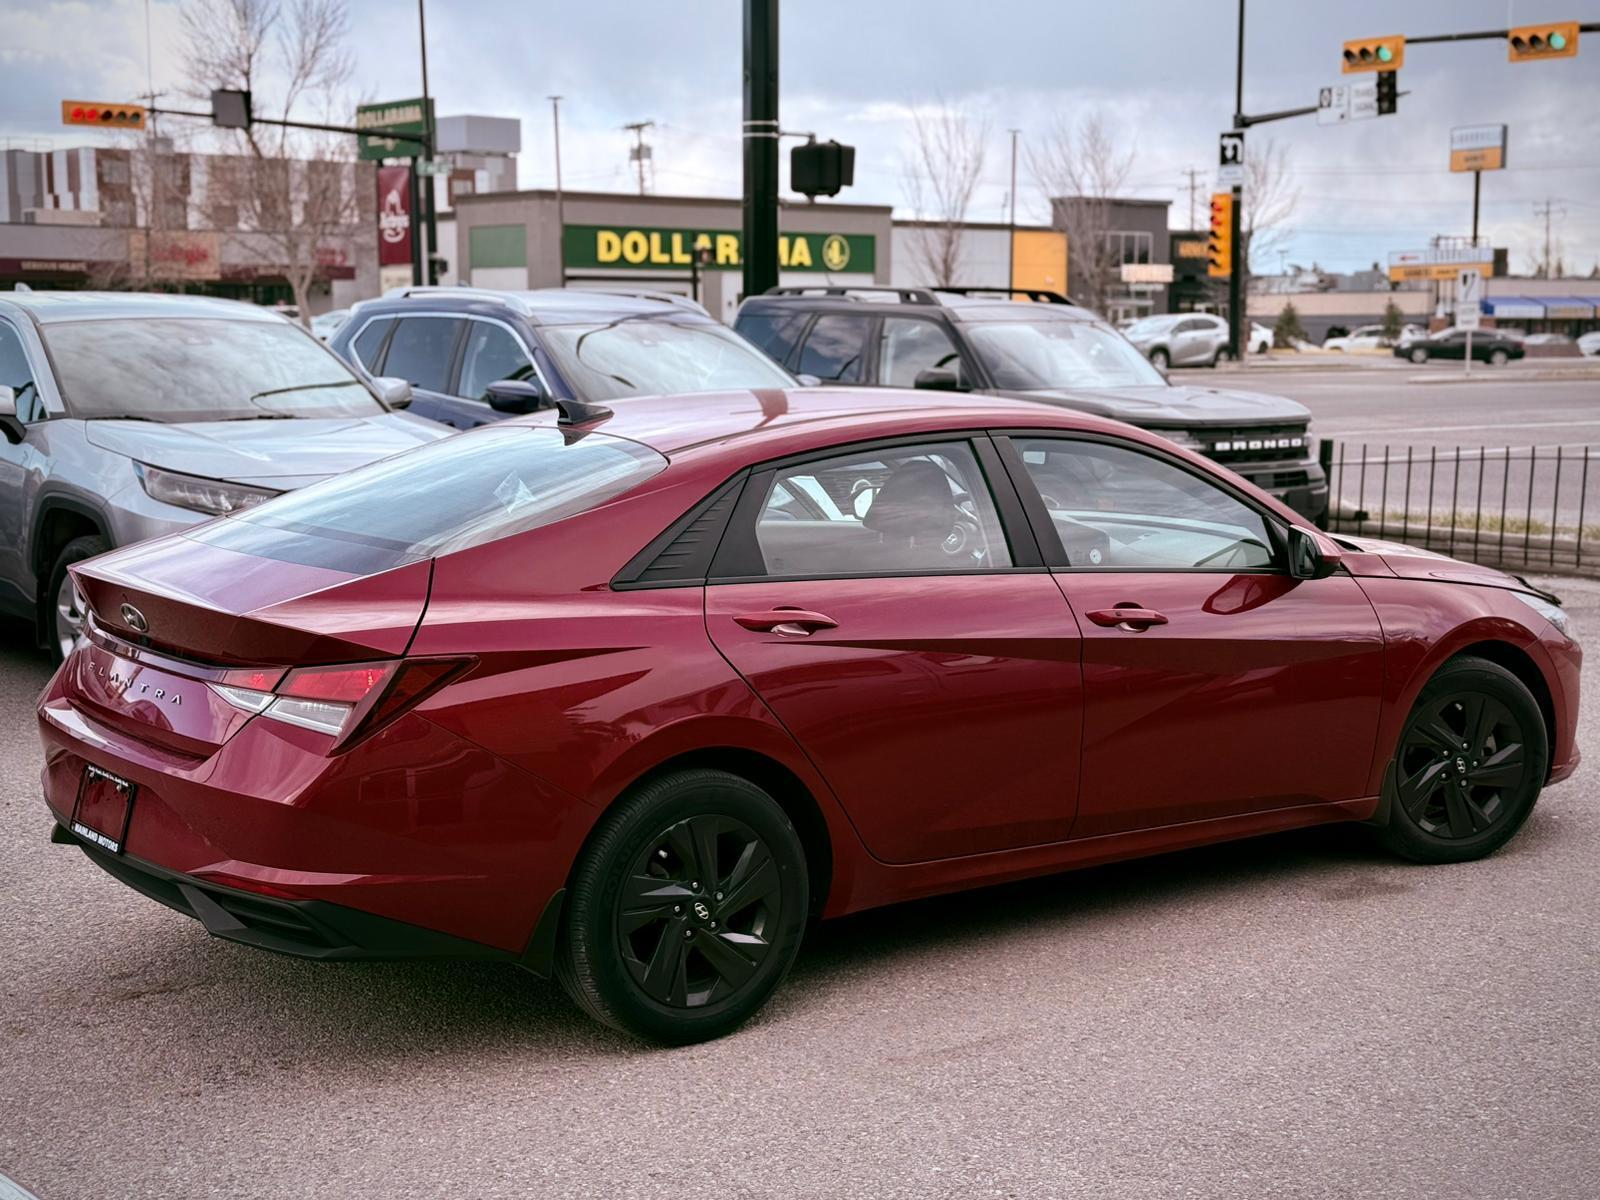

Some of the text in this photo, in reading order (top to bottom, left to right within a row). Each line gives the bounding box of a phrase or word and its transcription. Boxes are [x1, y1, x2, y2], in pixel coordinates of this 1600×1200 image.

[597, 230, 813, 267] DOLLRA
[1215, 438, 1303, 451] BRONCO
[88, 661, 182, 705] ELANTRA
